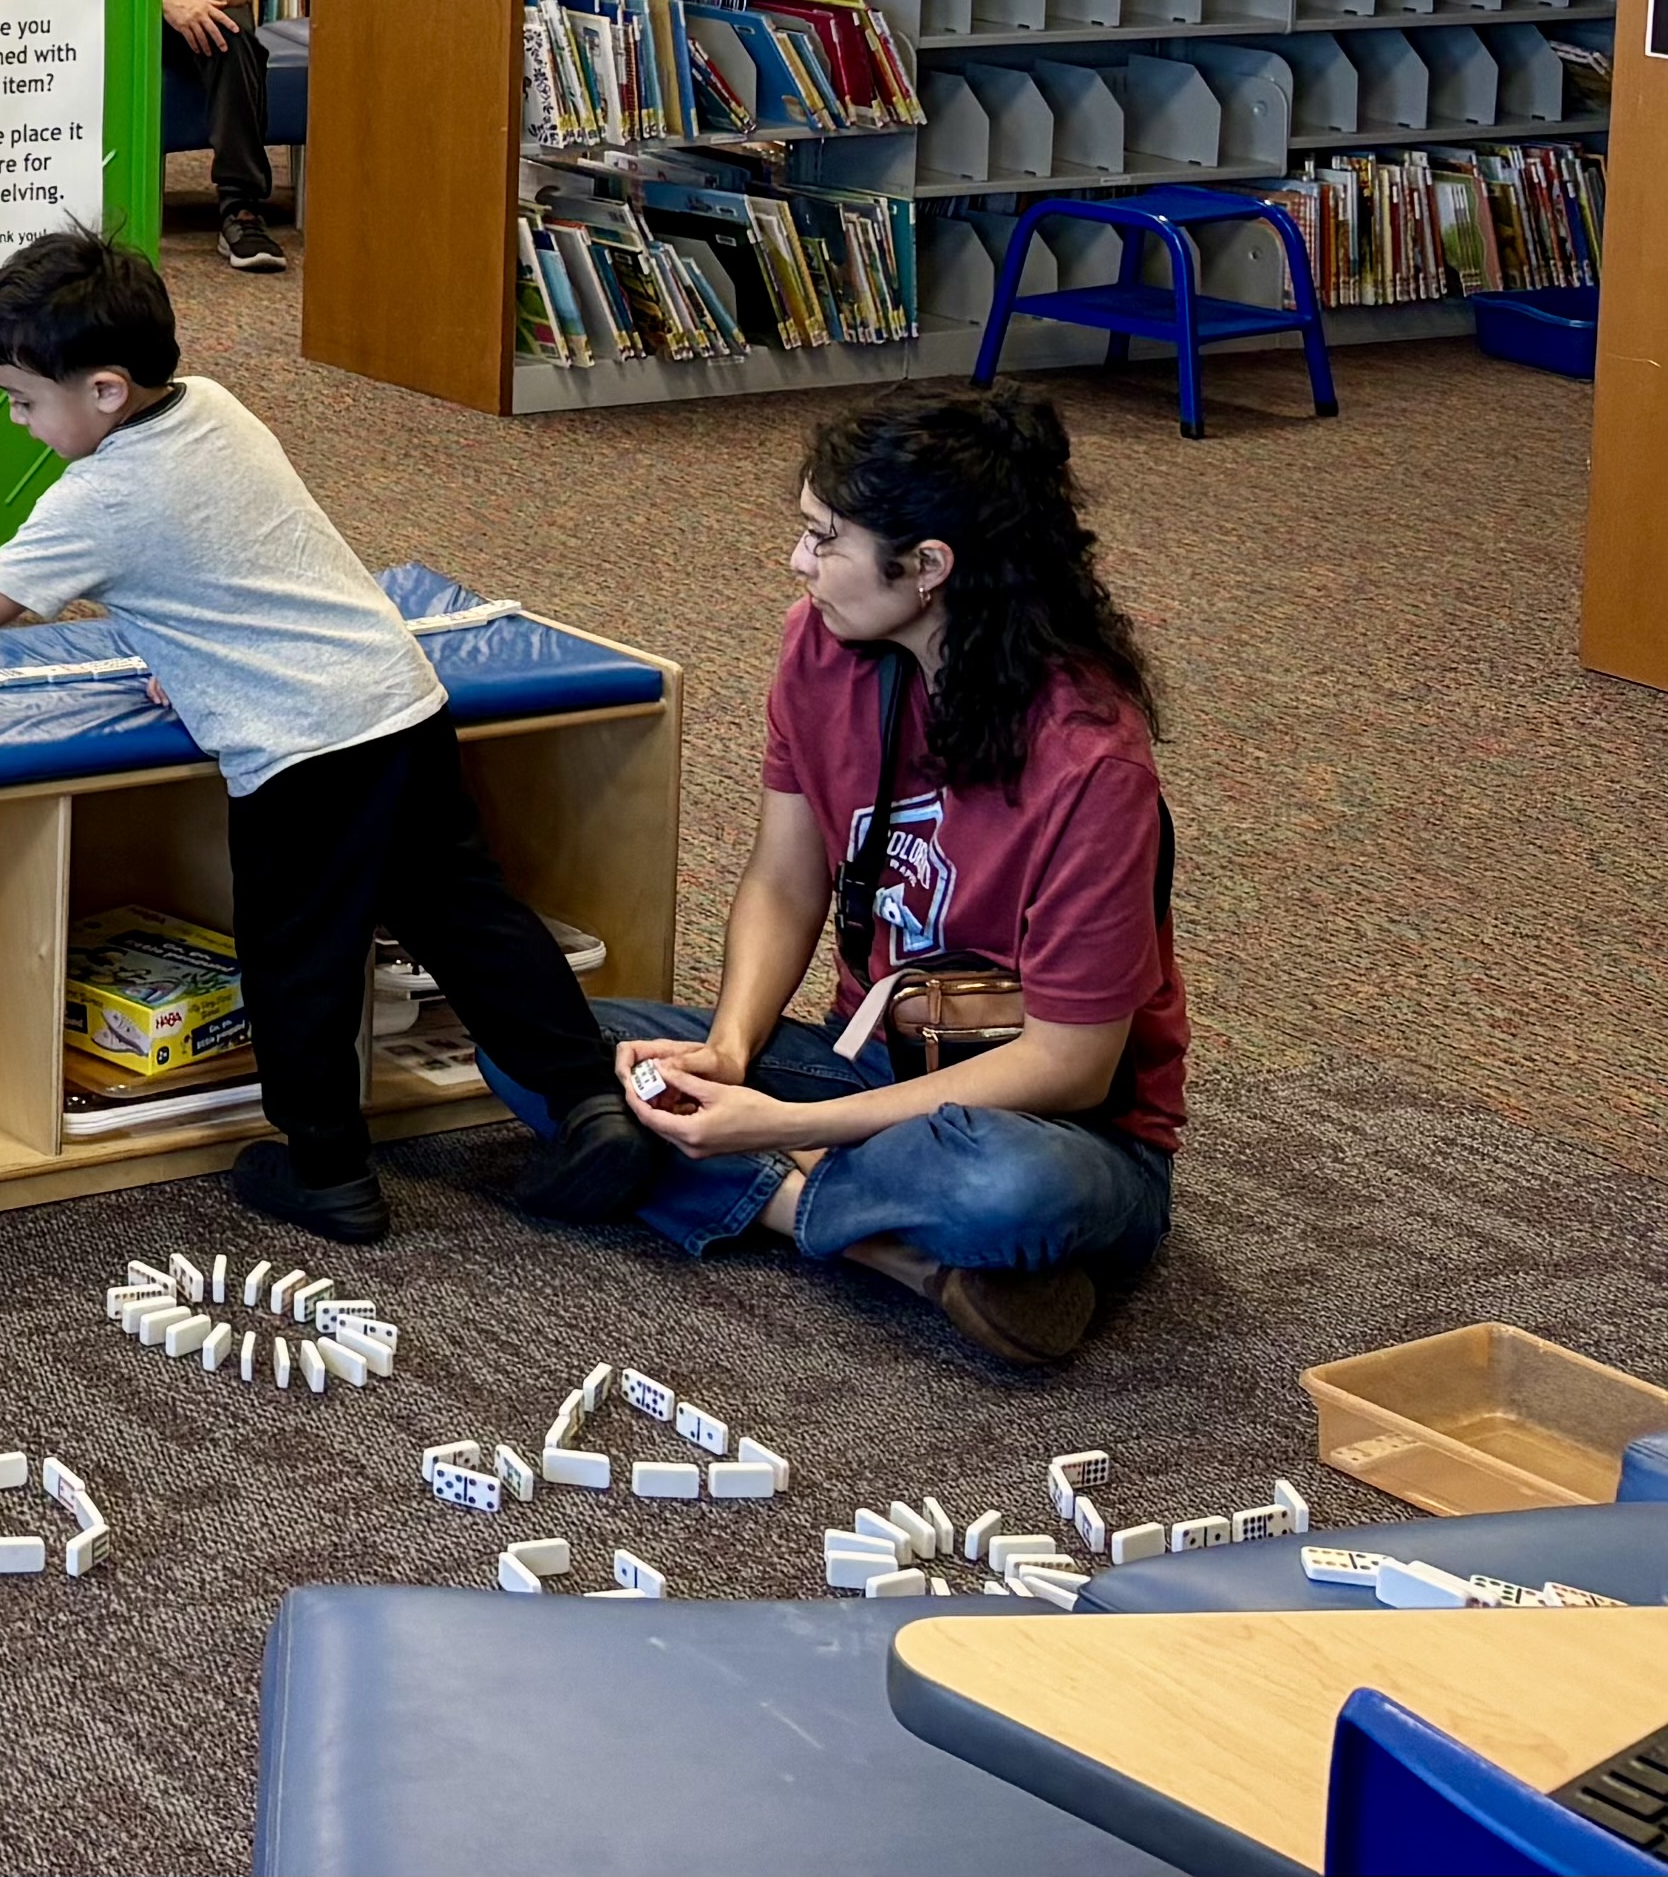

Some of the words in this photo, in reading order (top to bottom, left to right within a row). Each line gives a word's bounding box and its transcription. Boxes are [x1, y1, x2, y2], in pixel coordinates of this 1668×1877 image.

[18, 18, 51, 39] you
[34, 43, 76, 62] with
[3, 73, 54, 94] item?
[11, 124, 62, 148] place
[69, 122, 83, 140] it
[24, 154, 52, 172] for
